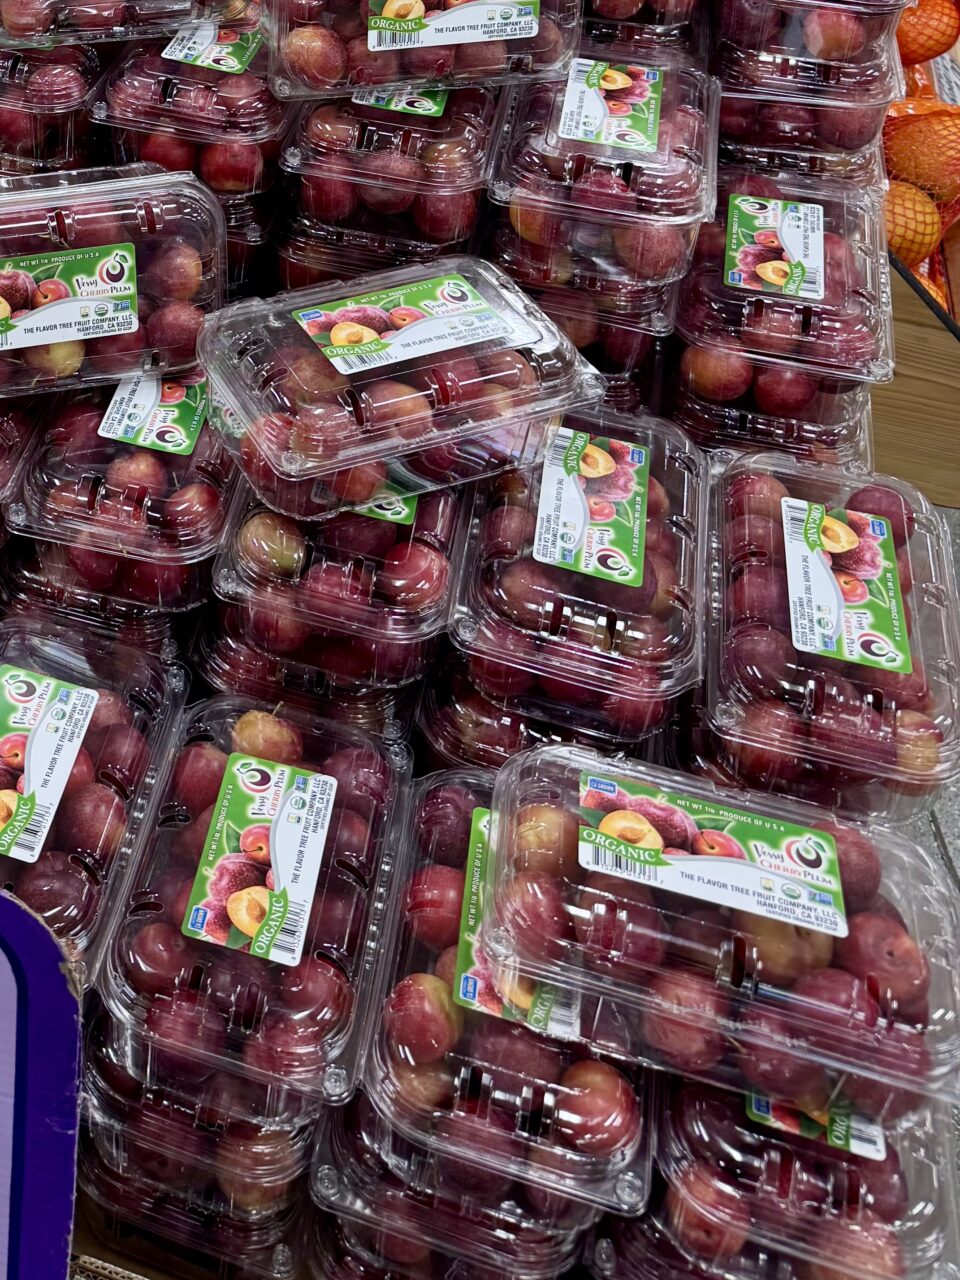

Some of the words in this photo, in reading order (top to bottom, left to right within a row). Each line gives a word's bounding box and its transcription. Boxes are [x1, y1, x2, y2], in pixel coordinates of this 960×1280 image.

[371, 18, 419, 30] ORGANIC
[36, 324, 57, 332] FLAVOR
[325, 341, 382, 355] ORGANIC
[567, 434, 586, 469] ORGANIC
[806, 504, 822, 545] ORGANIC
[312, 778, 321, 788] LLC
[317, 796, 325, 804] CA
[719, 809, 751, 822] PRODUCE
[302, 816, 312, 833] FRUIT
[299, 833, 309, 848] TREE
[583, 828, 656, 861] ORGANIC
[294, 848, 306, 871] FLAVOR
[291, 871, 300, 884] THE
[472, 867, 481, 893] PRODUCE
[680, 871, 695, 881] THE
[697, 876, 728, 890] FLAVOR
[730, 884, 750, 896] TREE
[752, 890, 775, 903] FRUIT
[822, 909, 837, 919] LLC
[801, 910, 812, 919] CA
[254, 896, 283, 952] ORGANIC
